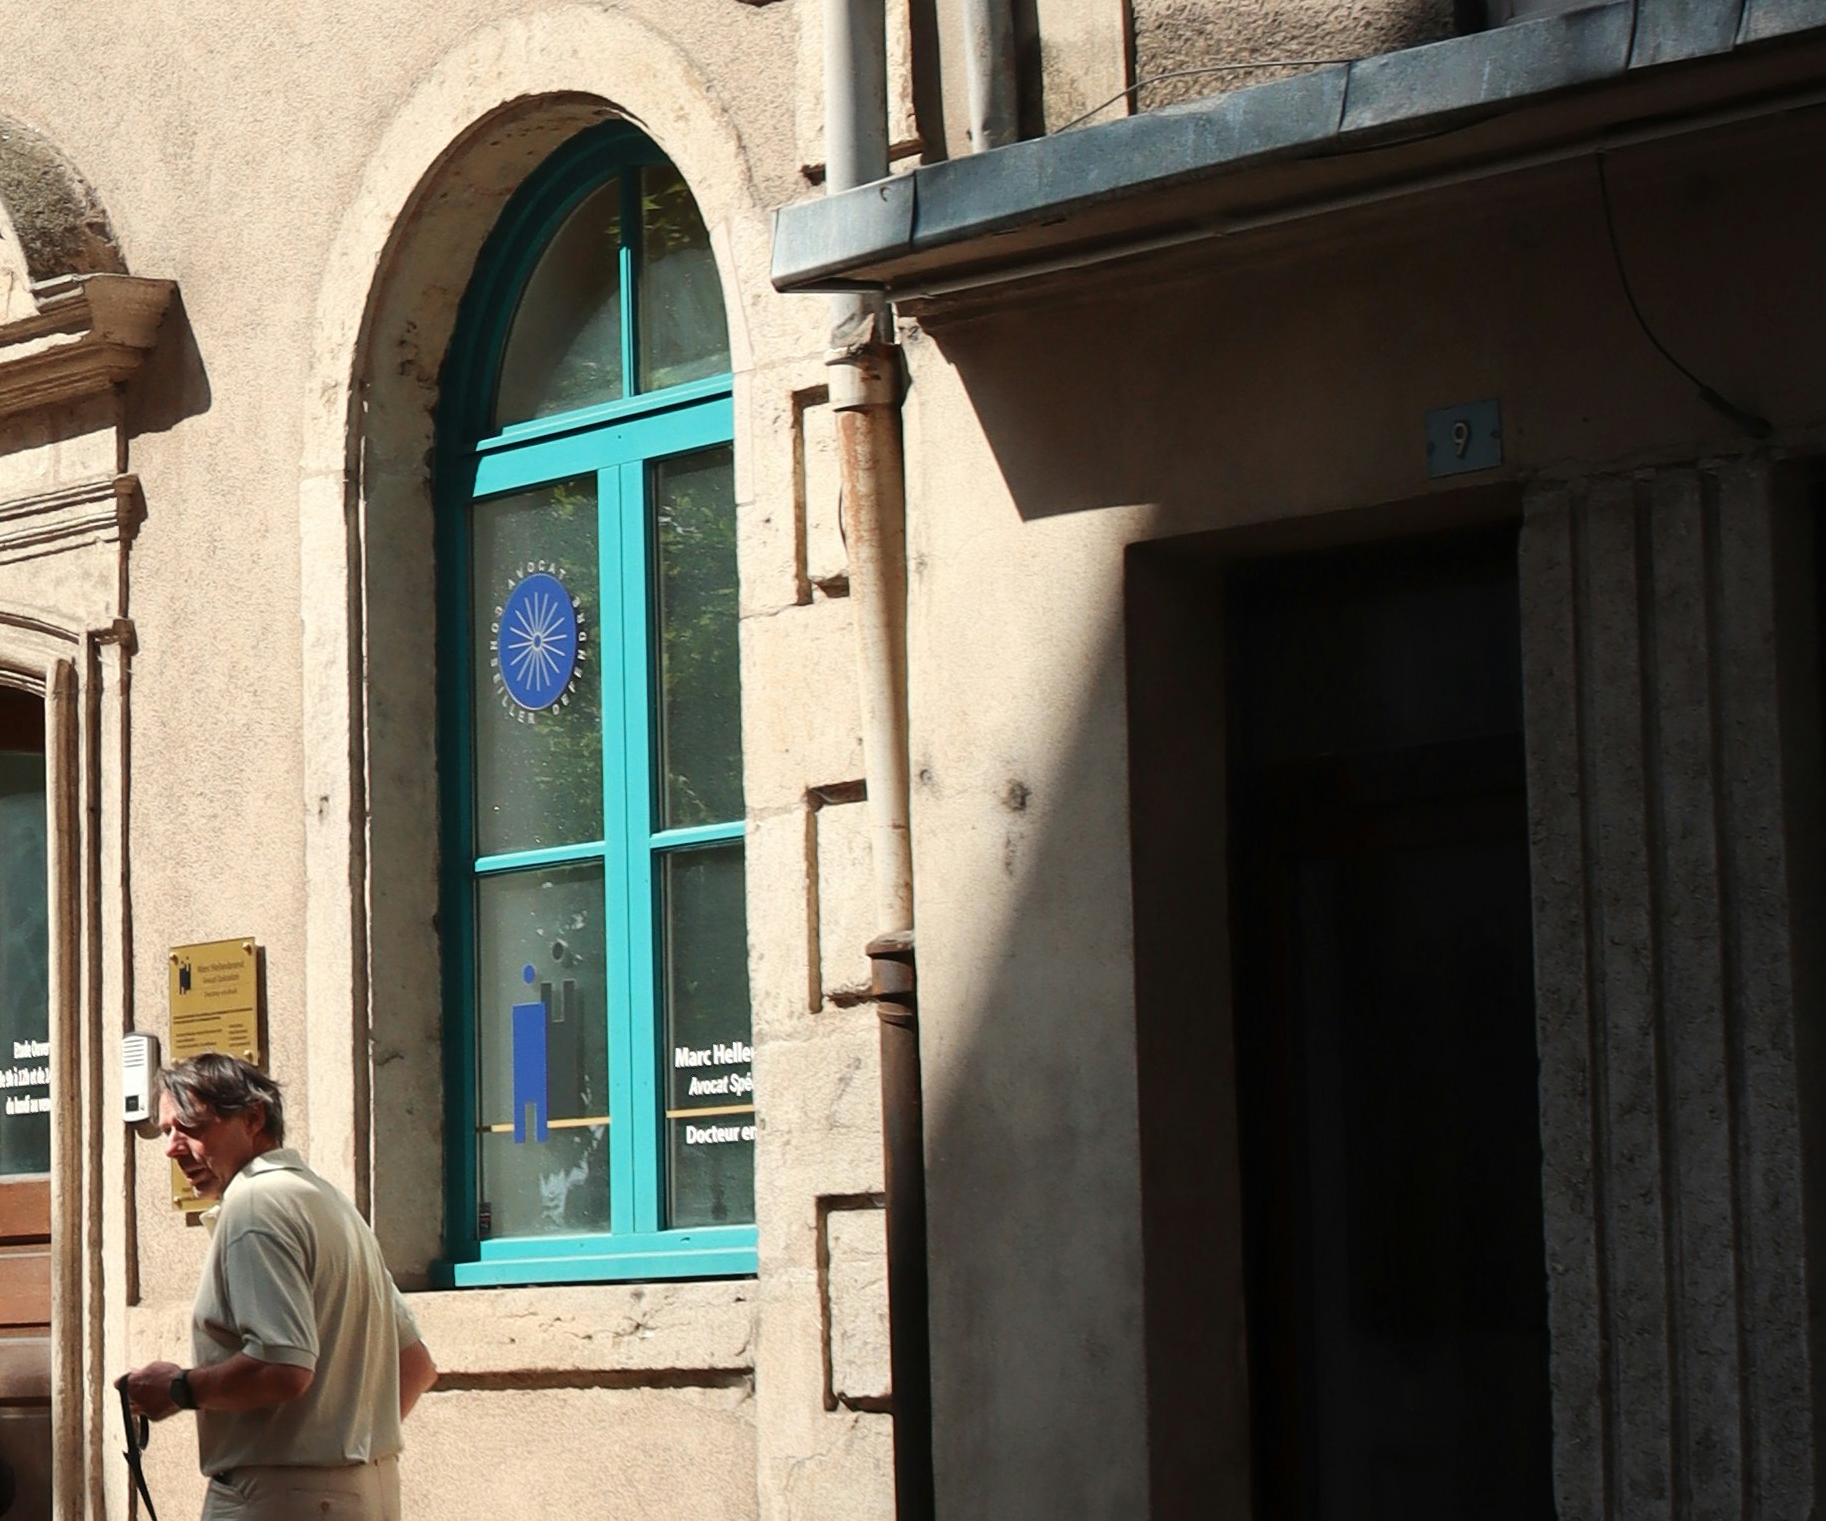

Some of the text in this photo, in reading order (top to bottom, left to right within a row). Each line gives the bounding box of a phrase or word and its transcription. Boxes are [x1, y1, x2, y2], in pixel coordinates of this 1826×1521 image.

[1453, 421, 1469, 459] 9
[507, 559, 567, 590] AVOCAT
[675, 1041, 754, 1068] Marc Helle
[688, 1076, 729, 1096] Avocat
[686, 1125, 740, 1145] Docteur
